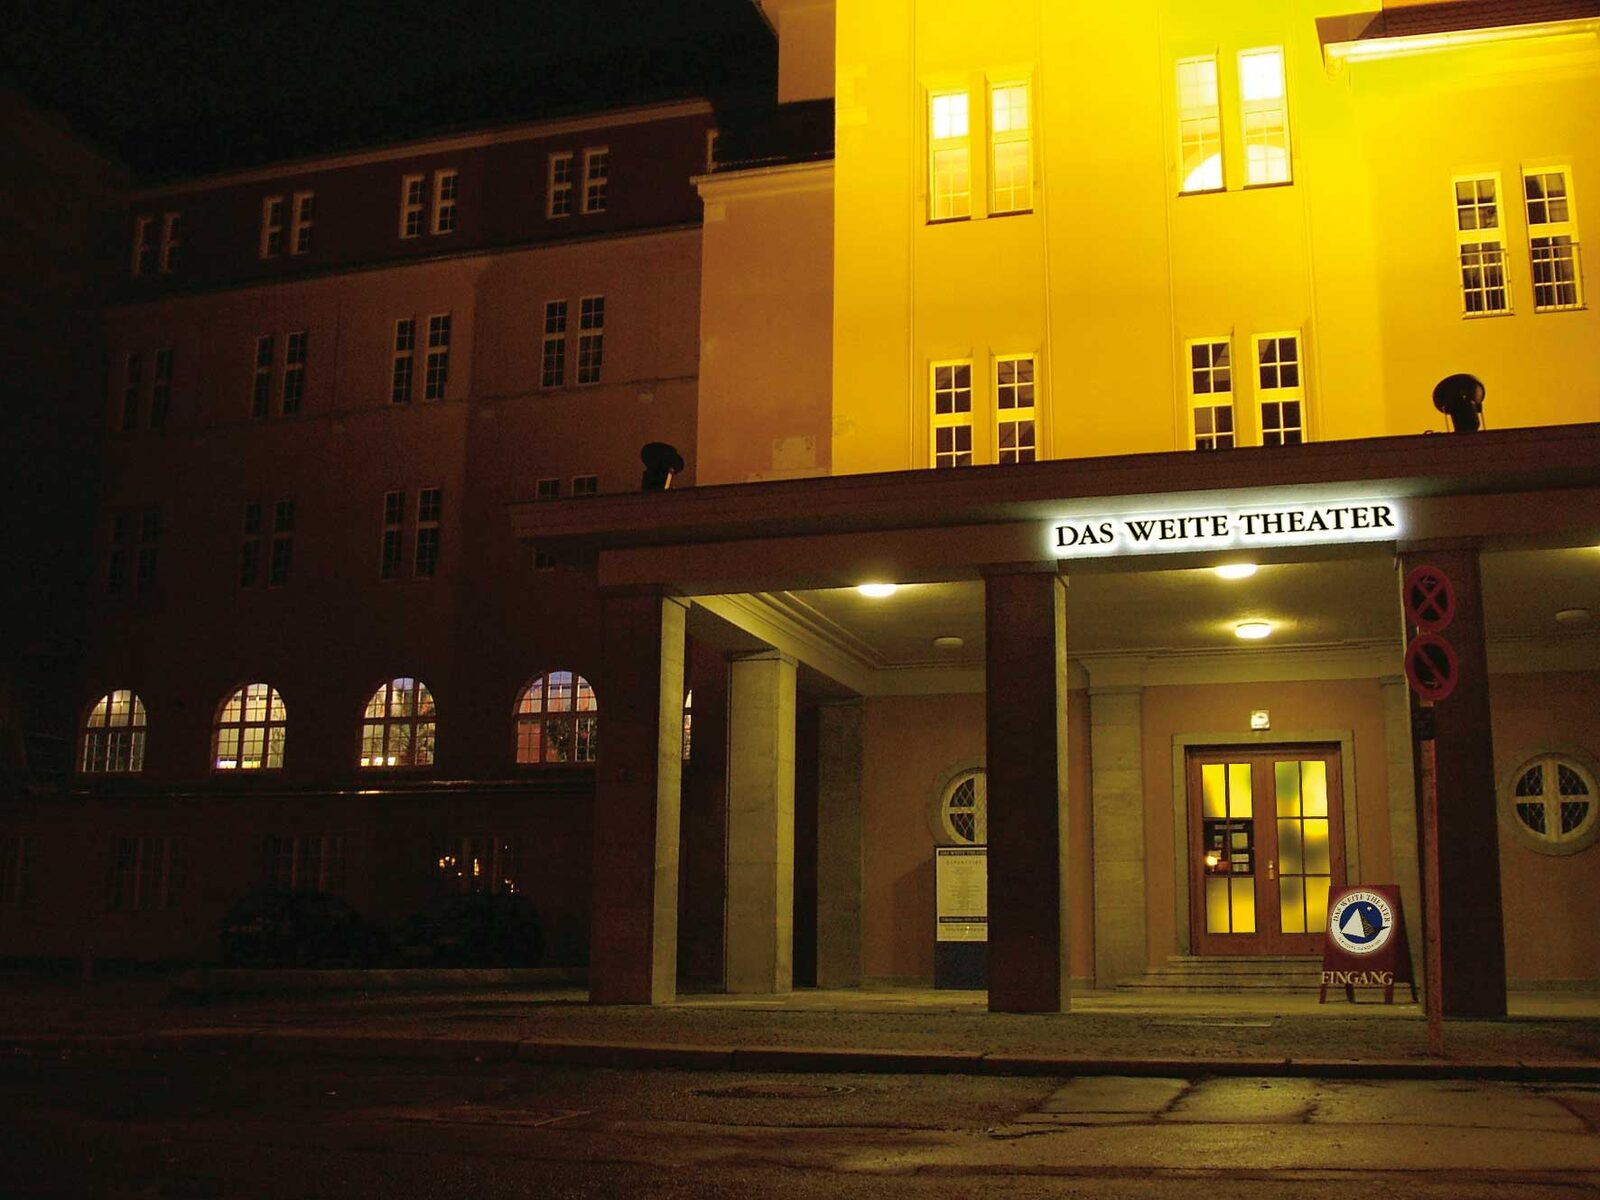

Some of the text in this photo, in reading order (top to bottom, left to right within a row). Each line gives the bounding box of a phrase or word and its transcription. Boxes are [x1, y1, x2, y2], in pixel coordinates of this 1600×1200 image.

[1056, 505, 1395, 547] DAS WEITE THEATER
[1366, 894, 1391, 922] THEATER
[1321, 970, 1394, 985] EINGANG
